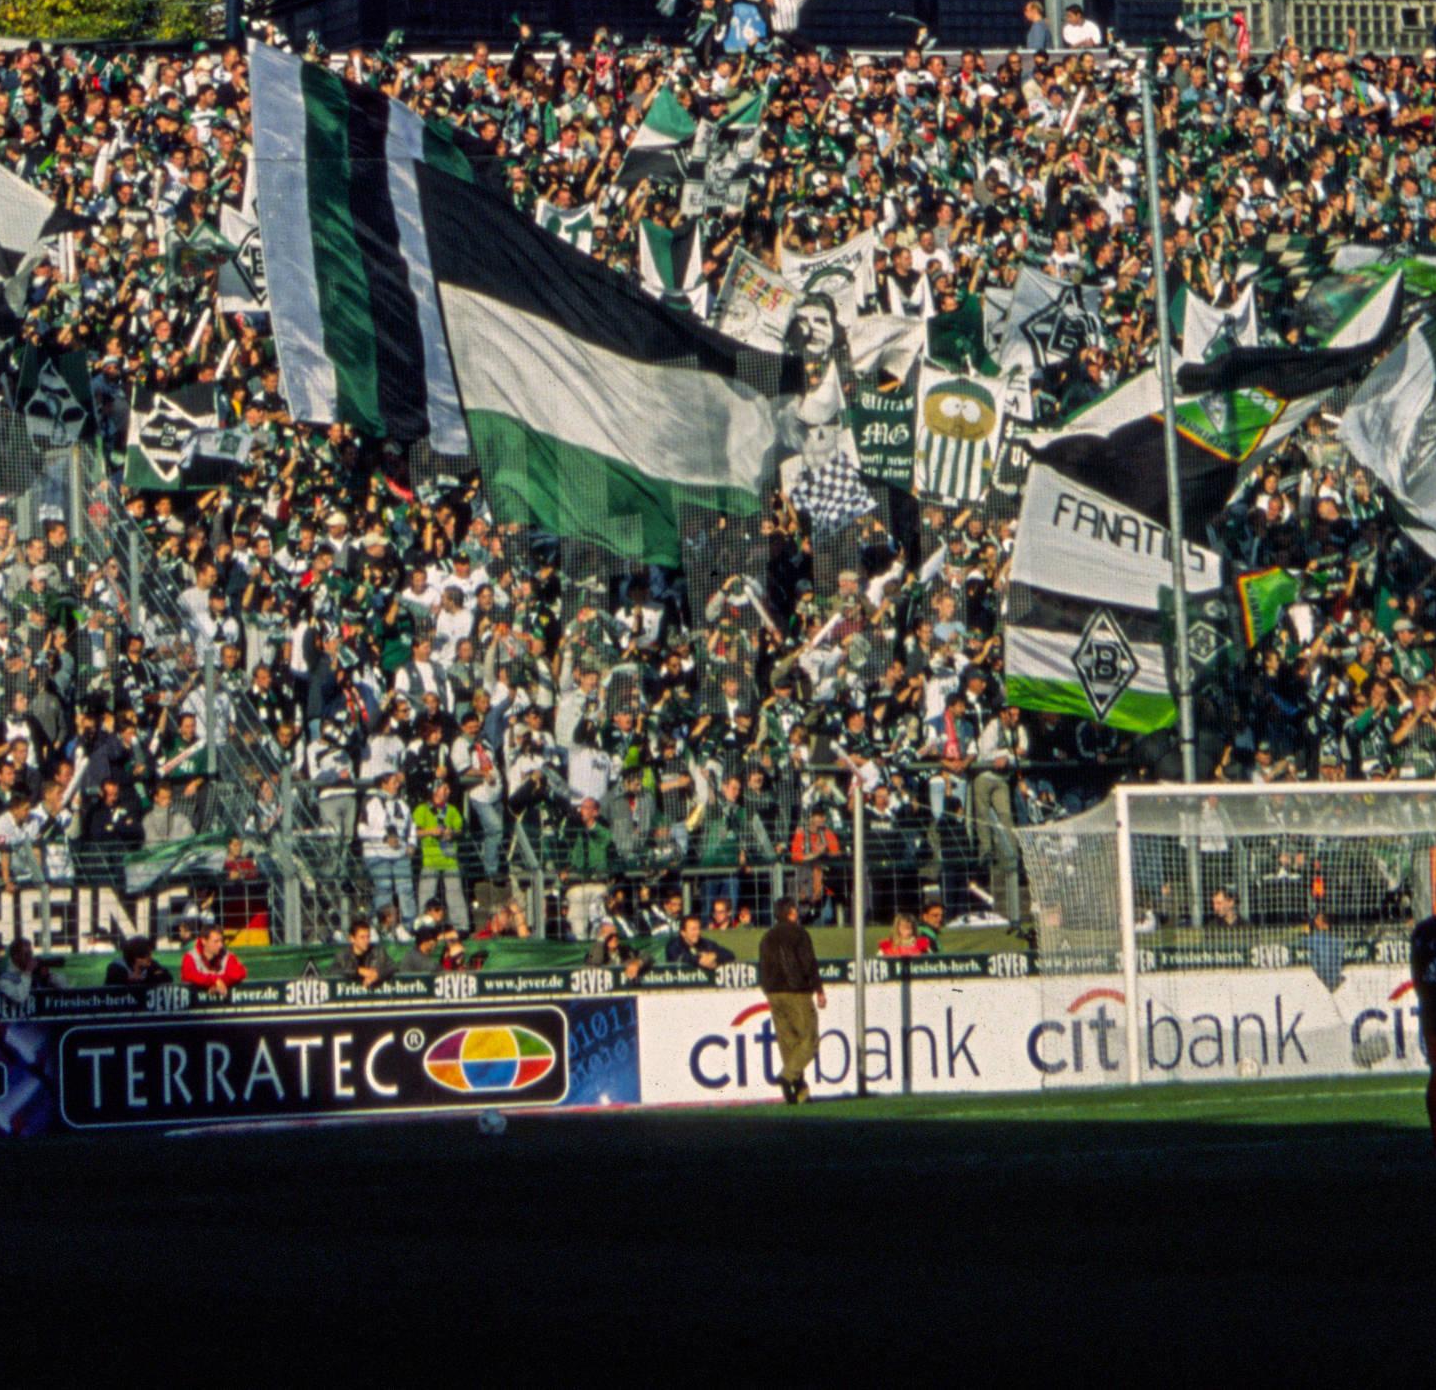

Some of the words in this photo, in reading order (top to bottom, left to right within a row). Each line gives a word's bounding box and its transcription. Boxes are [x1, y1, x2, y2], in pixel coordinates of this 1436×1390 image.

[1052, 492, 1206, 573] FANATIS
[145, 982, 190, 1011] JEVER
[285, 978, 330, 1006] JEVER
[434, 972, 477, 999] JEVER
[484, 973, 564, 992] www.jever.de
[570, 968, 613, 995] JEVER
[715, 960, 757, 988] JEVER
[988, 952, 1028, 978] JEVER
[1251, 943, 1290, 968] JEVER
[77, 1031, 399, 1109] TERRATEC
